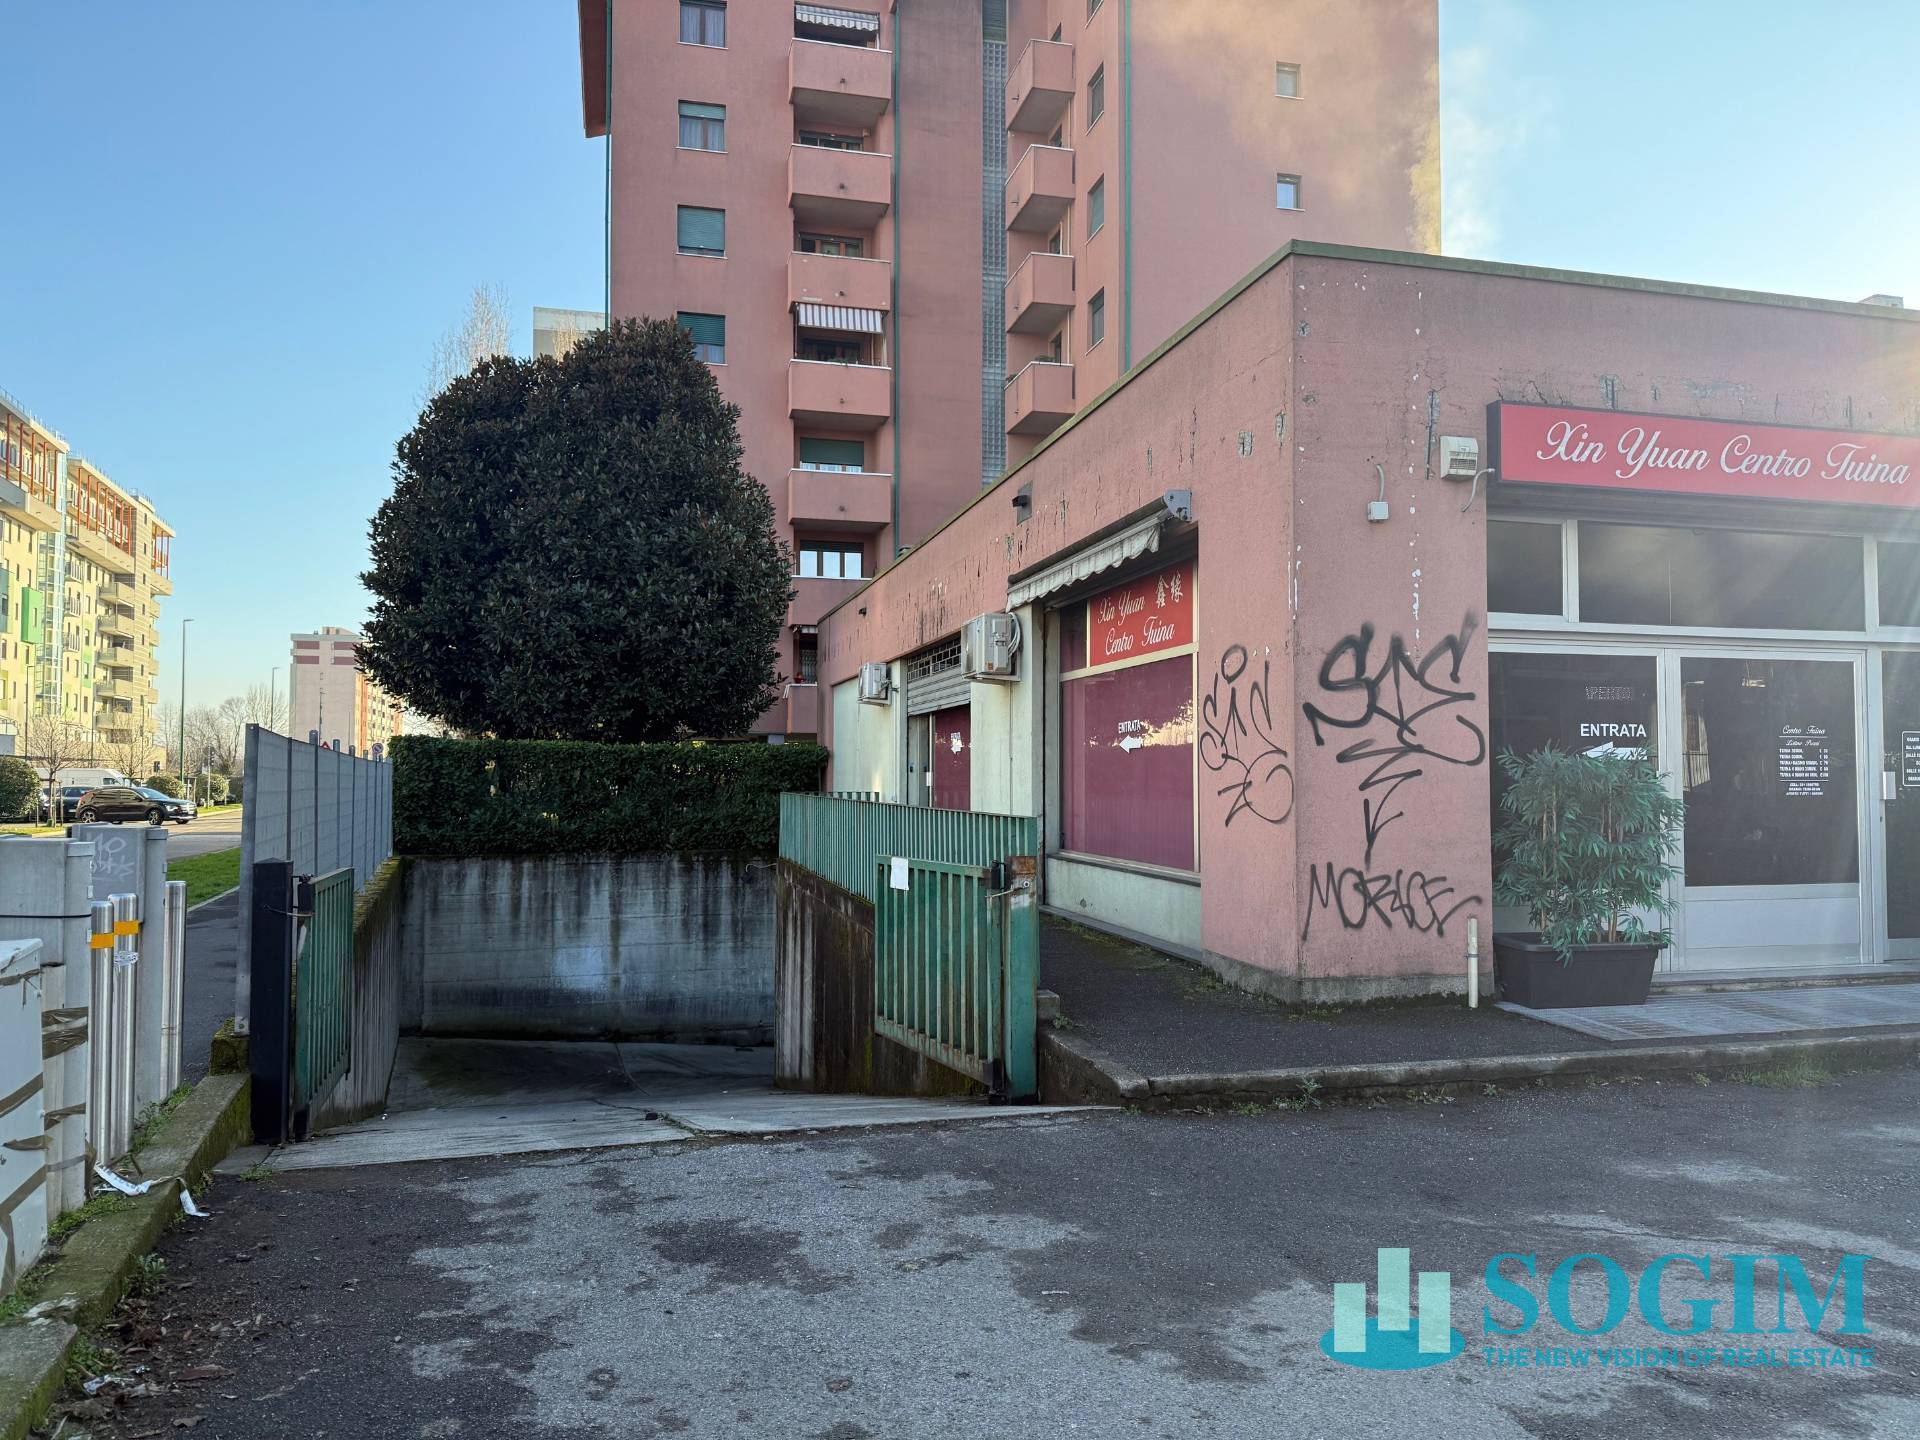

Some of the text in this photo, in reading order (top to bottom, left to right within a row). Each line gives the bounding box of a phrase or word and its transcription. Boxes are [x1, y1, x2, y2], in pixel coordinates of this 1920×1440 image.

[1536, 420, 1911, 485] Xin Yuan Centro Tuina
[1097, 591, 1145, 626] Xin Yuan
[1105, 615, 1175, 656] Centro Tuina
[1118, 719, 1141, 734] ENTRATA
[1580, 723, 1647, 738] ENTRATA
